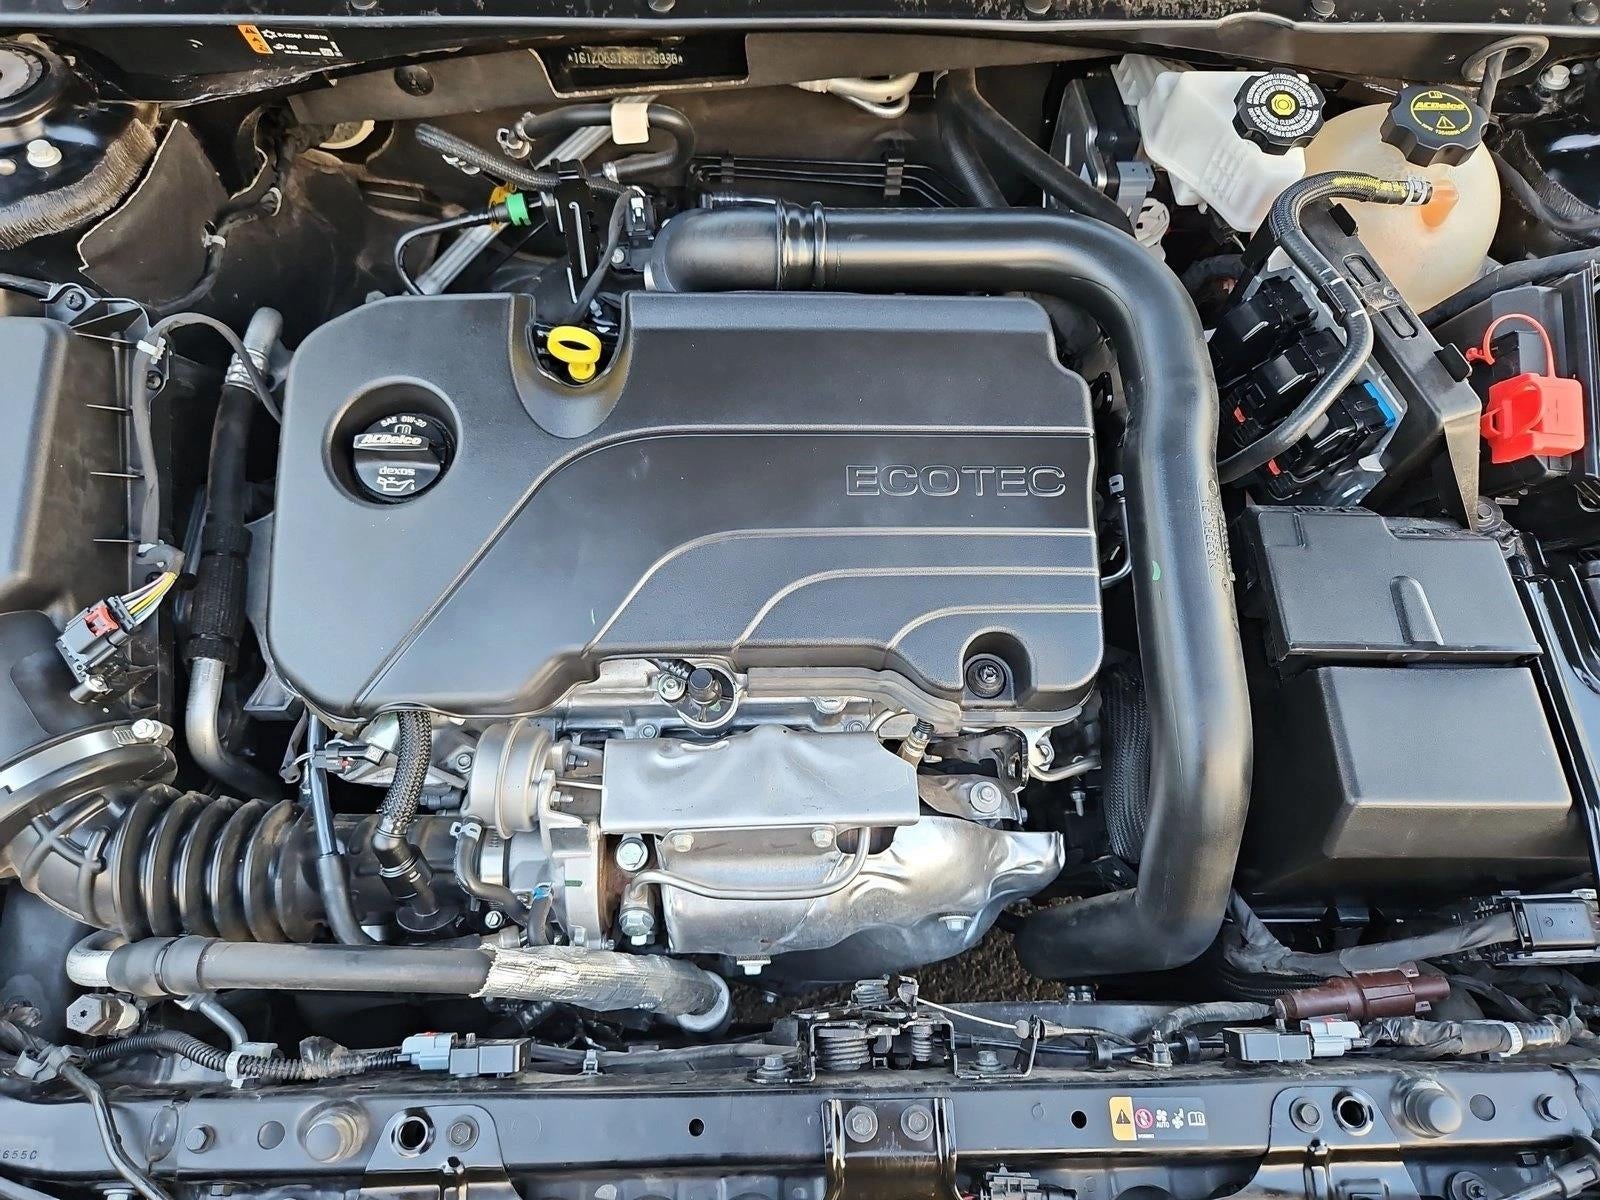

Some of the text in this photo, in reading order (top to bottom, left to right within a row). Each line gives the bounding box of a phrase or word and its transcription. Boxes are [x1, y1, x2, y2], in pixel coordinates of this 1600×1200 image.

[380, 415, 427, 428] SAE 0W-20
[361, 434, 422, 446] ACDelco
[379, 466, 416, 476] dexos
[845, 465, 1066, 497] ECOTEC
[1156, 1121, 1170, 1129] AUTO
